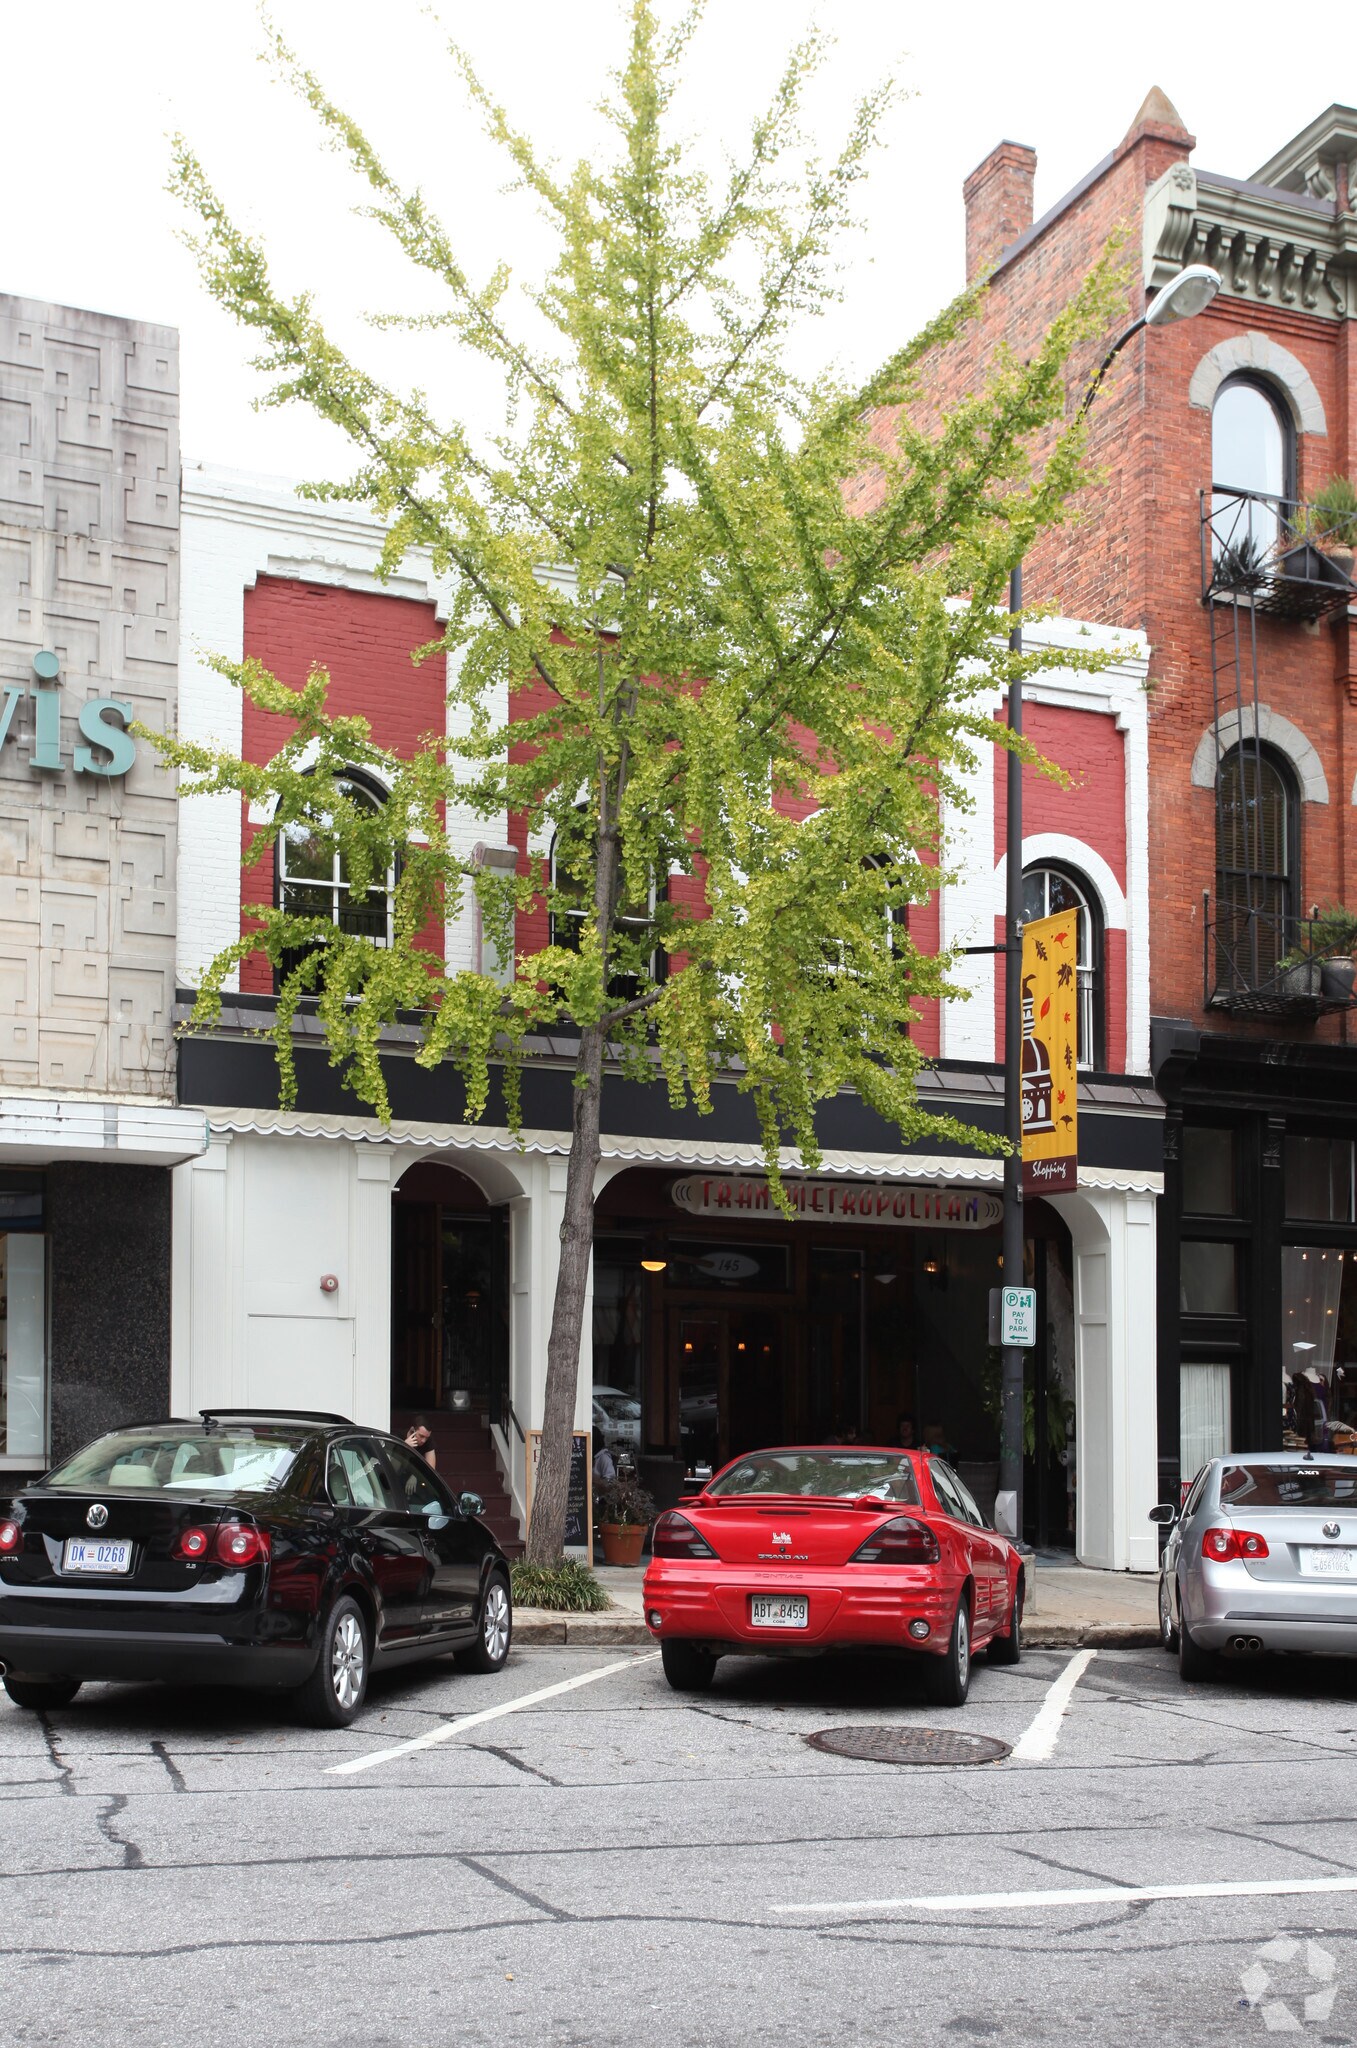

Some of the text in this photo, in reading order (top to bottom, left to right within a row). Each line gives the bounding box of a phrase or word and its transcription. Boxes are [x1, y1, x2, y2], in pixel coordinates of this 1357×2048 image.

[1032, 1160, 1067, 1180] Shopping
[699, 1179, 979, 1222] TRANMETROPOLITAN
[718, 1258, 740, 1272] 145
[71, 1545, 125, 1563] DK 0268
[754, 1603, 805, 1619] ABT 8459
